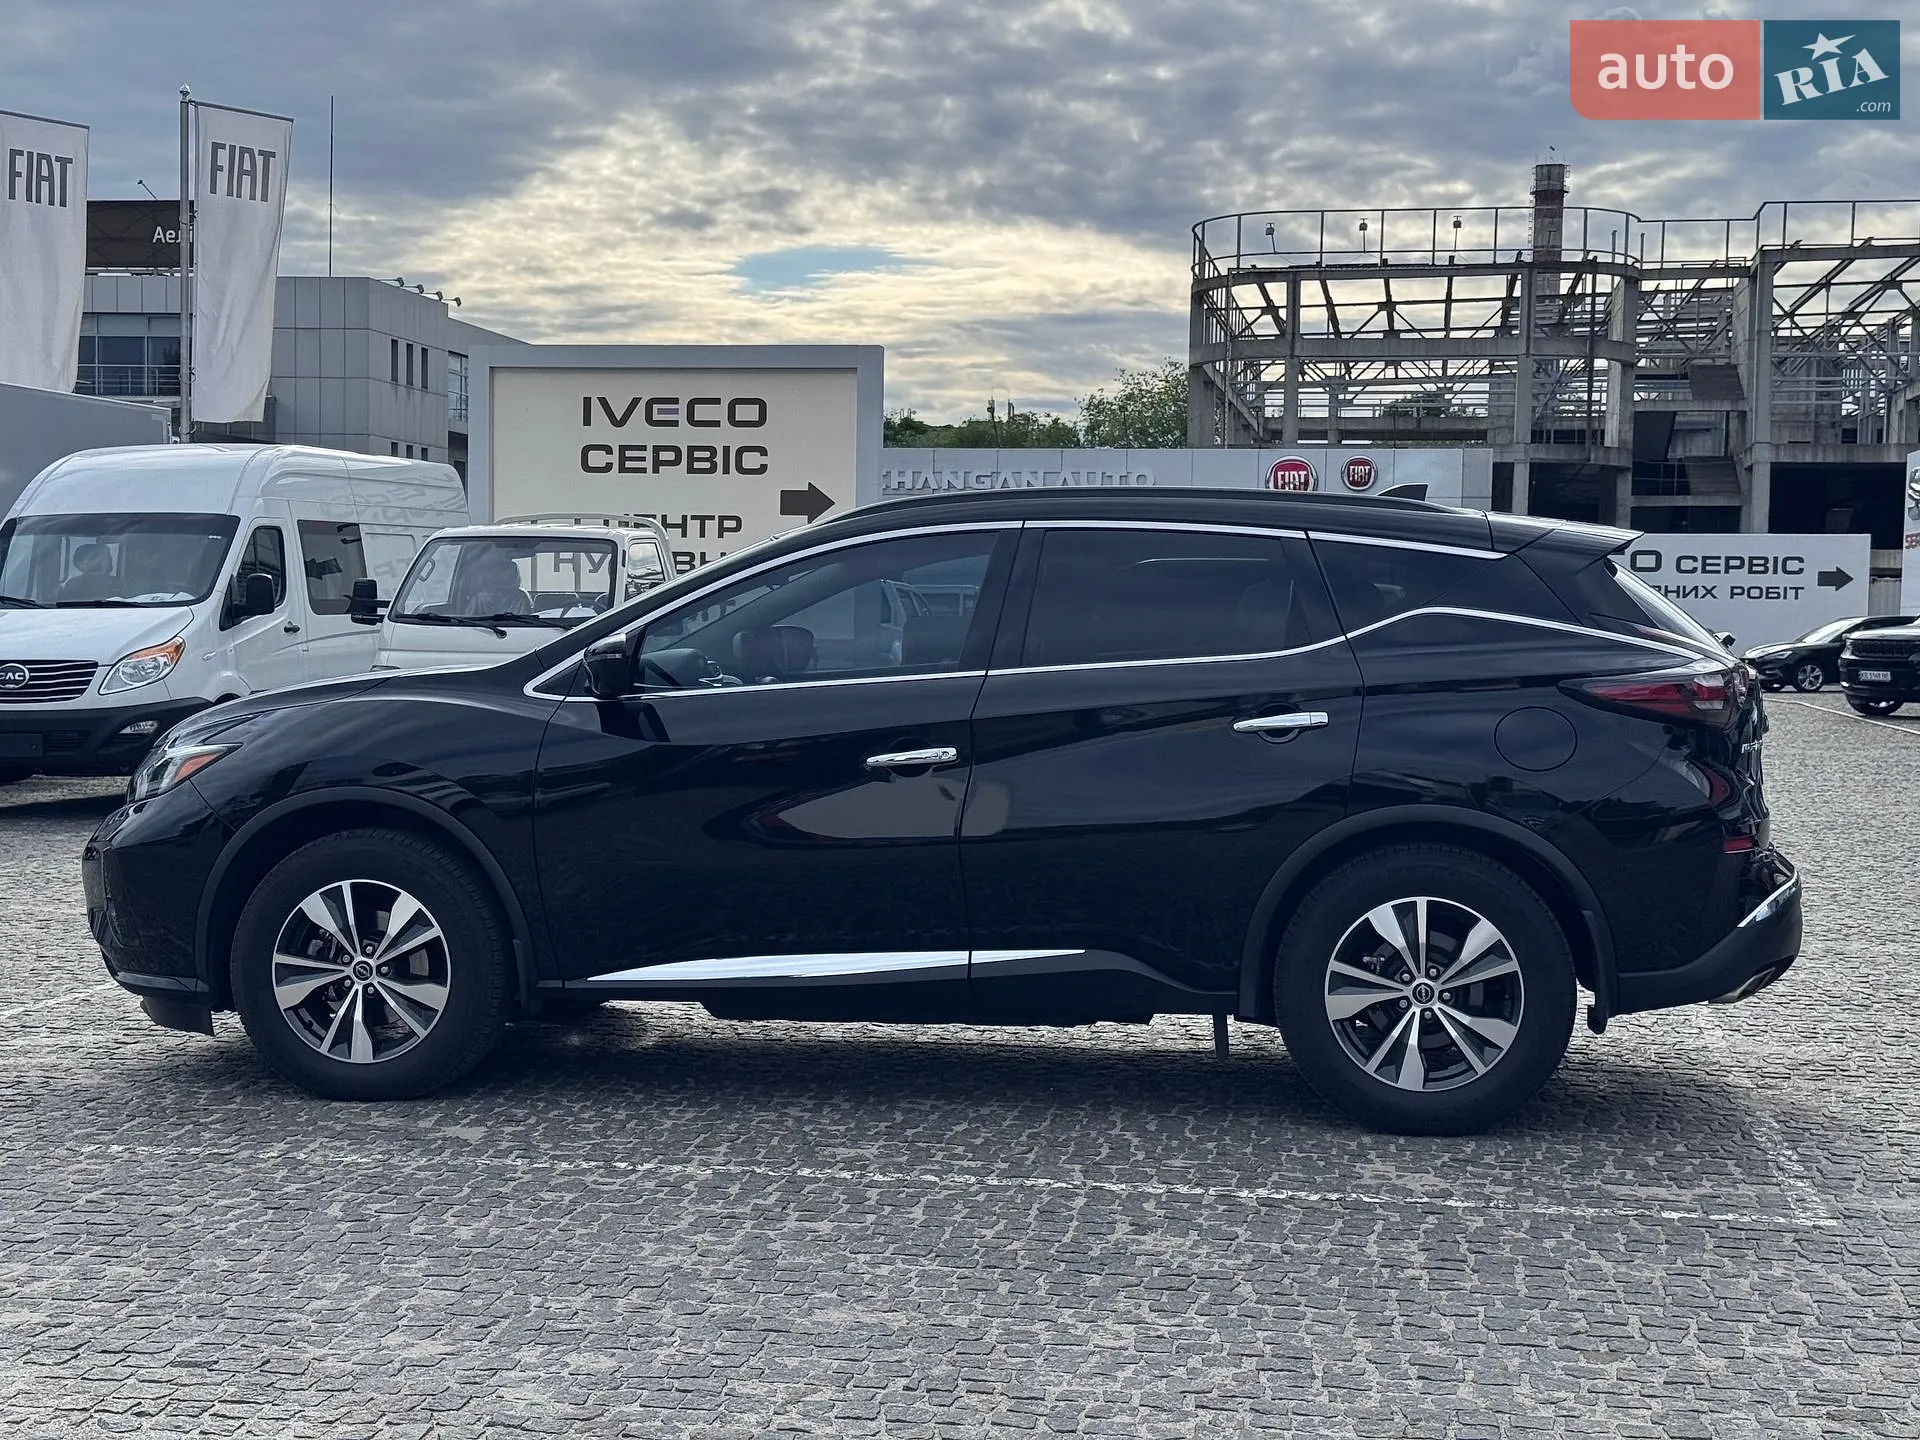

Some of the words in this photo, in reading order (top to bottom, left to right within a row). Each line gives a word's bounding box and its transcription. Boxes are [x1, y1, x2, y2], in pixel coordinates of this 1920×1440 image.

[8, 148, 74, 208] FIAT
[210, 141, 276, 202] FIAT
[582, 396, 768, 428] IVECO
[581, 444, 769, 475] СЕРВІС
[882, 470, 1043, 491] HANGAN
[1056, 470, 1157, 488] AUTO
[1277, 470, 1308, 491] FIAT
[1348, 465, 1371, 483] FIAT
[1675, 555, 1805, 575] СЕРВІС
[1729, 585, 1805, 601] РОБІТ
